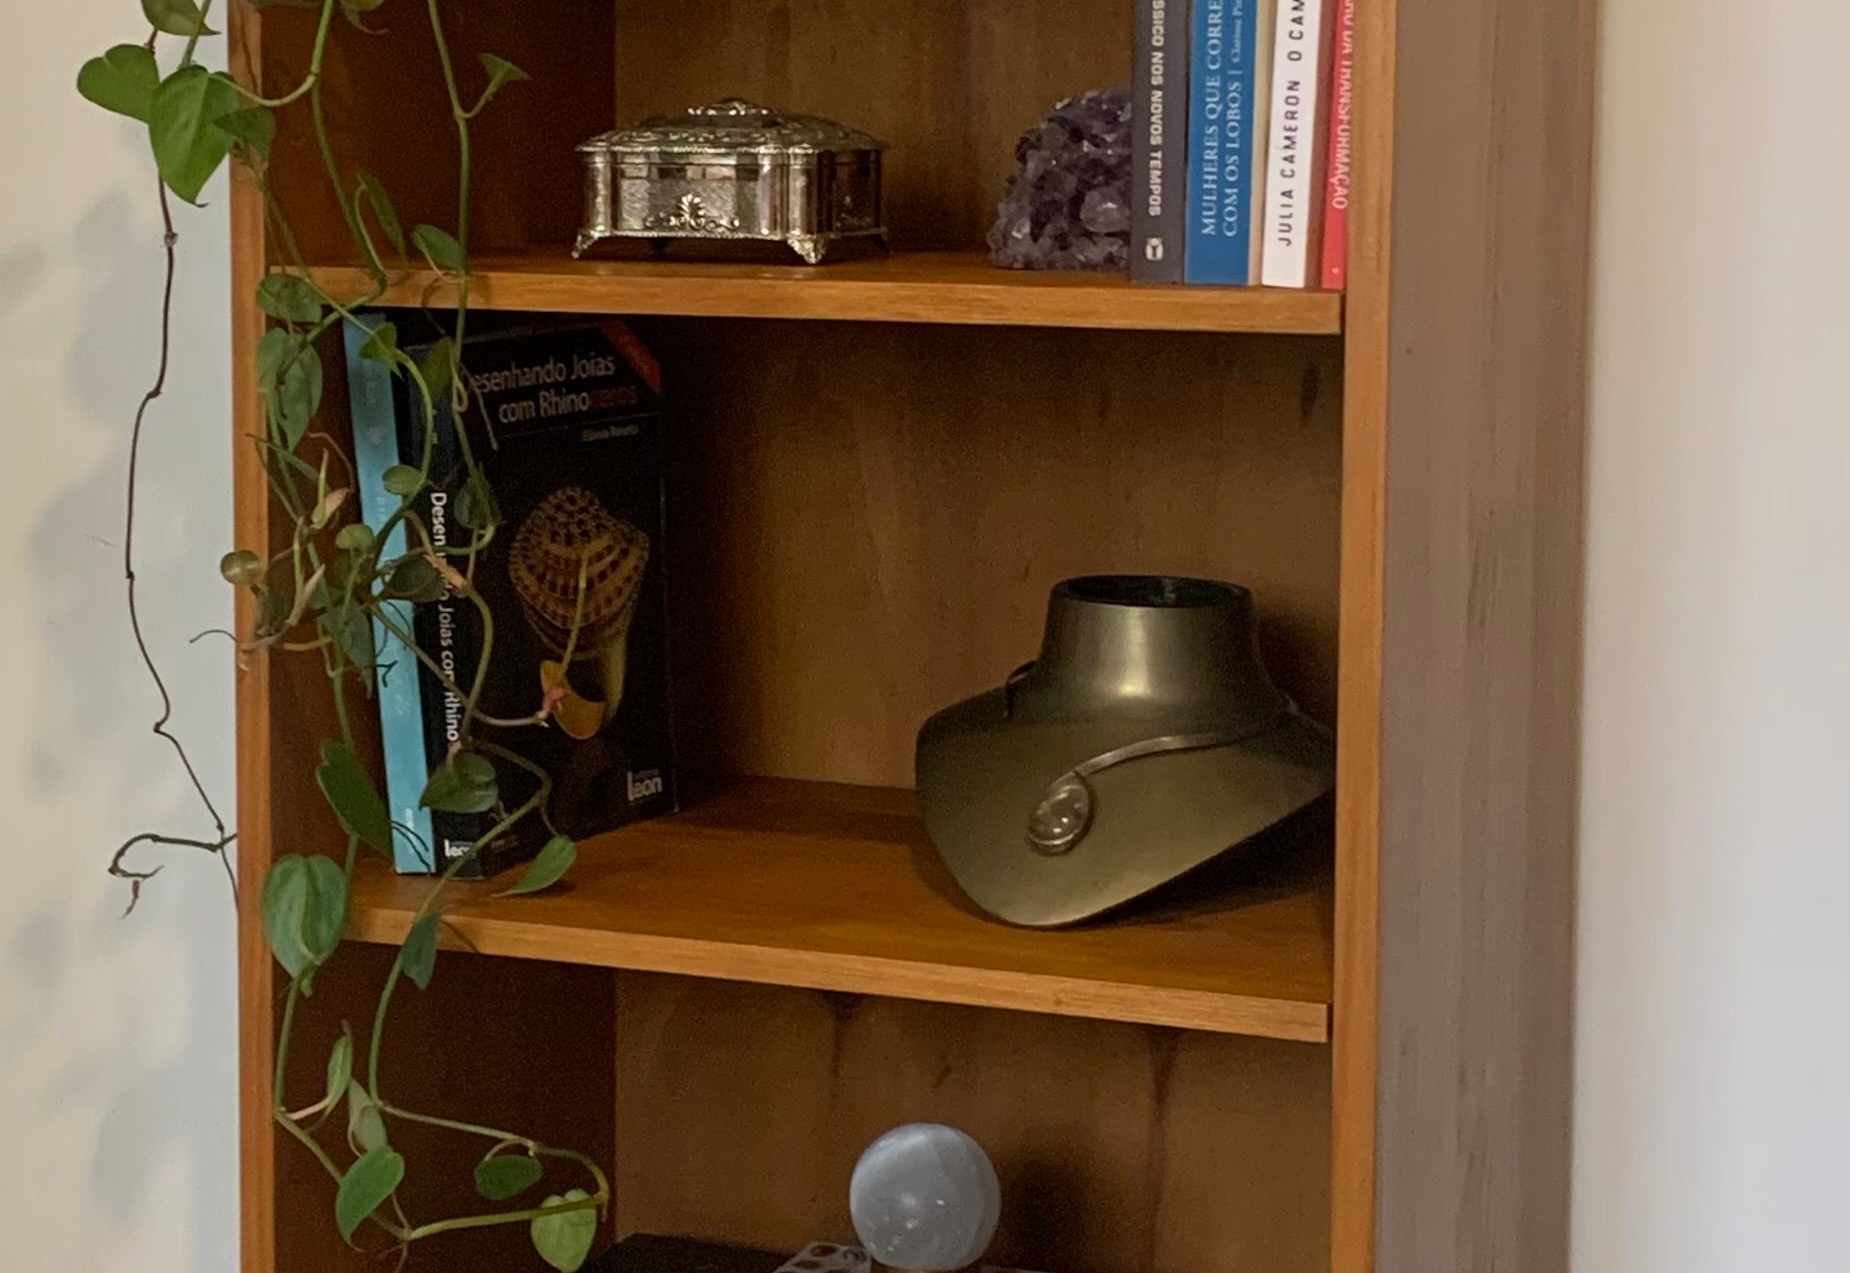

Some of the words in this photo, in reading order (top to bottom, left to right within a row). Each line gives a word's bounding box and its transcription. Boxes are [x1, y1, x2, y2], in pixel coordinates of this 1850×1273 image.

[1150, 51, 1165, 86] NOS
[1286, 50, 1304, 62] O
[1150, 90, 1164, 146] NOVOS
[1204, 75, 1223, 120] QUE
[1225, 81, 1243, 149] LOBOS
[1279, 80, 1301, 179] CAMERON
[1148, 150, 1163, 217] TEMPOS
[1200, 125, 1220, 236] MULHERES
[1224, 154, 1241, 182] OS
[1222, 187, 1239, 237] COM
[1277, 189, 1295, 248] JULIA
[570, 350, 617, 380] Joias
[498, 399, 536, 424] com
[437, 603, 457, 648] Joias
